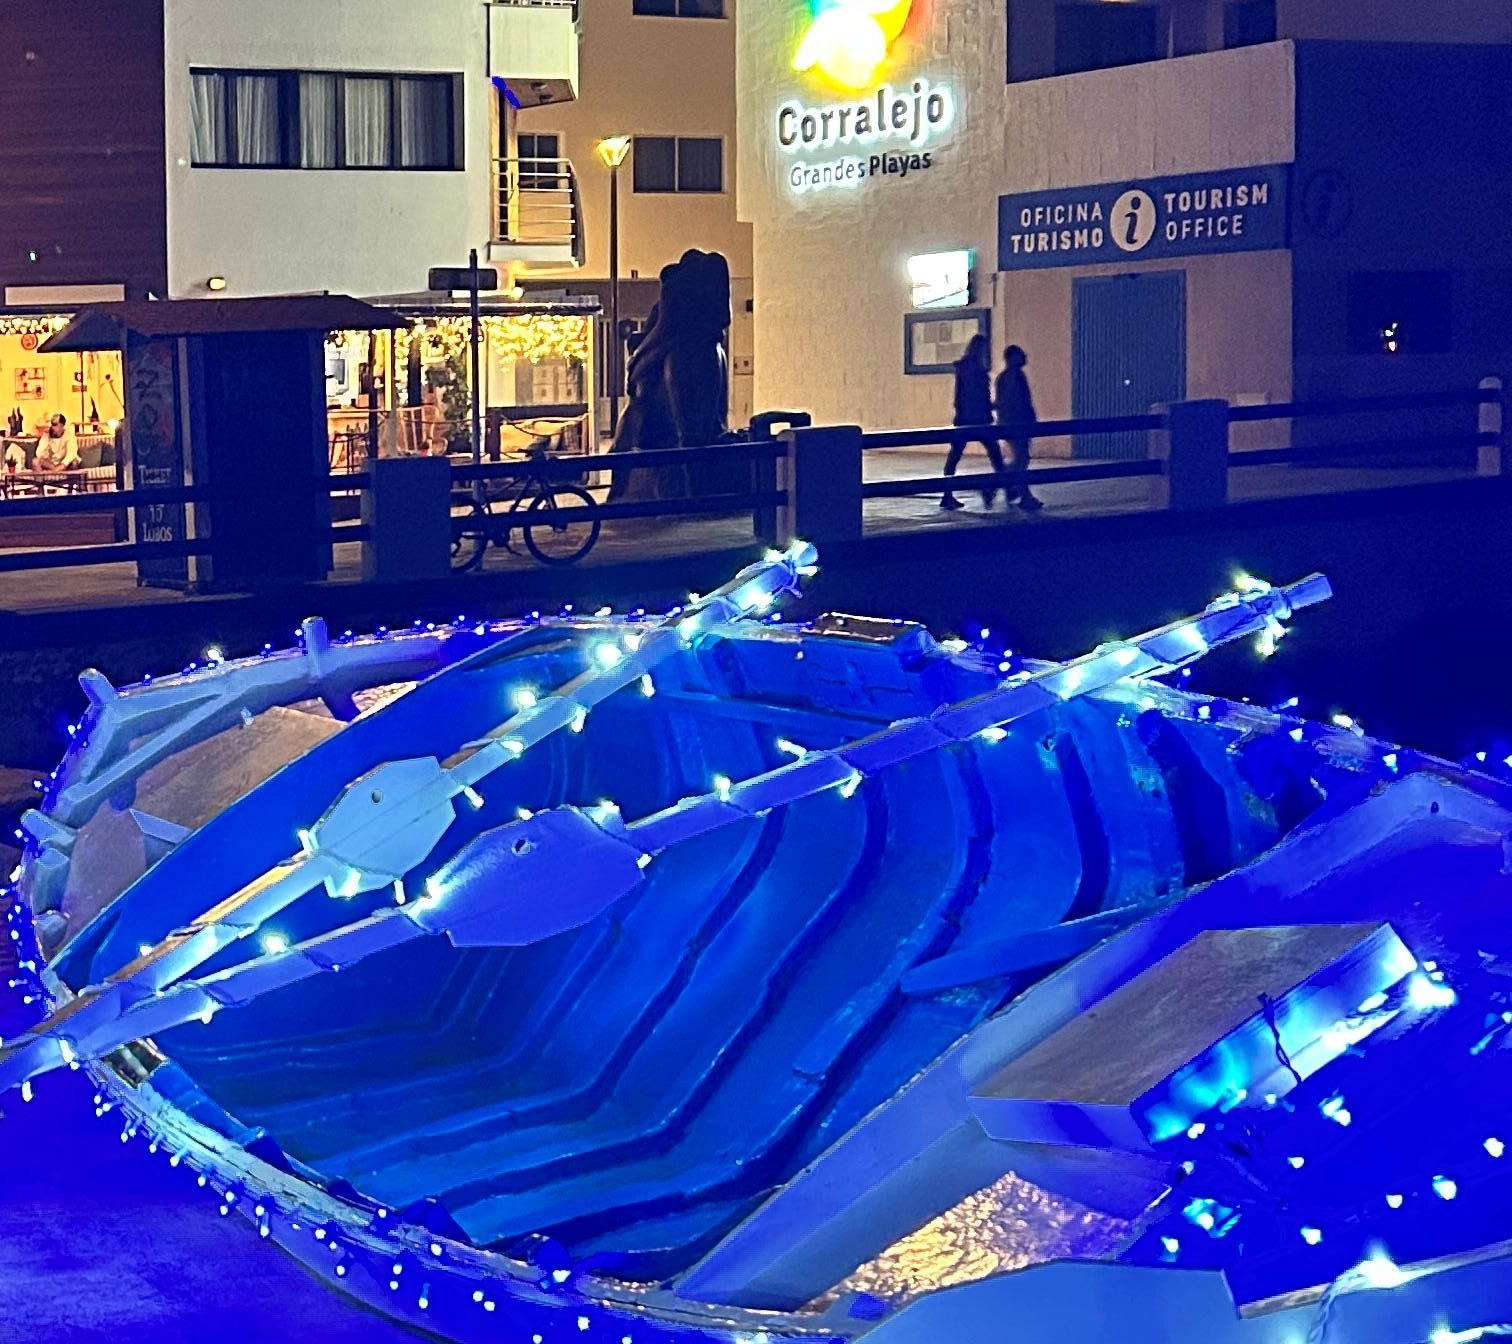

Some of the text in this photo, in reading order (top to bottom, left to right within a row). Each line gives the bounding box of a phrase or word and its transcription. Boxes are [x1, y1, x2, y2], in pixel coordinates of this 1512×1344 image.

[778, 82, 945, 146] Corralejo
[790, 152, 932, 187] Grandes Playas
[1164, 183, 1269, 213] TOURISM
[1020, 202, 1104, 228] OFICINA
[1165, 214, 1244, 242] OFFICE
[1010, 227, 1105, 255] TURISMO
